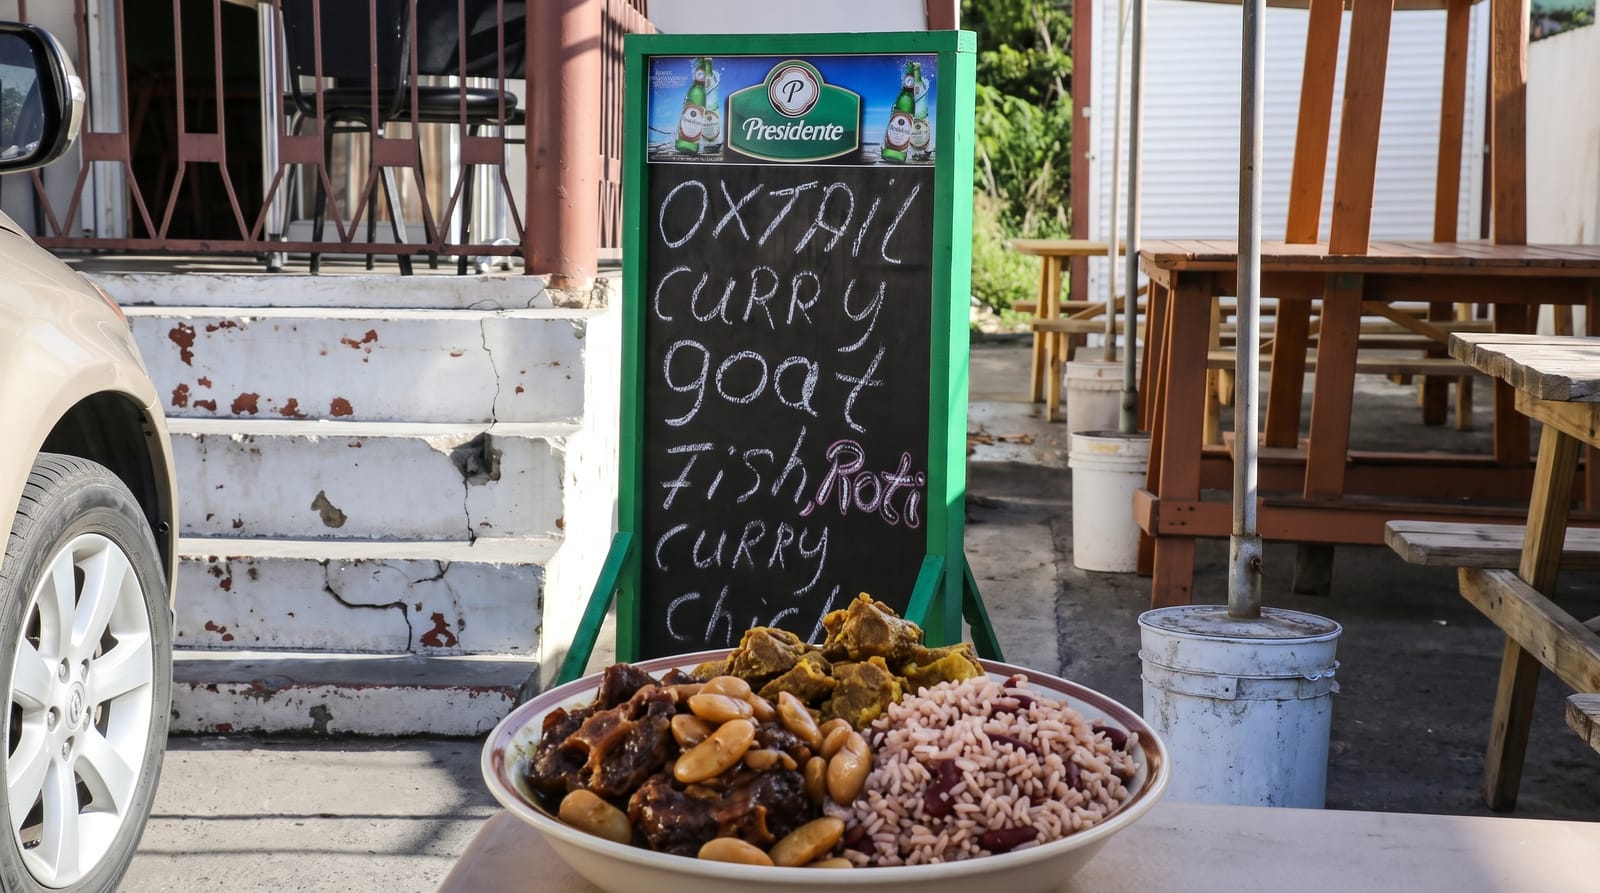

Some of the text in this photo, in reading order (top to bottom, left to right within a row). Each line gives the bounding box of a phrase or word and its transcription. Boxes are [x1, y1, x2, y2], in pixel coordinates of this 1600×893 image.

[782, 79, 804, 103] P
[742, 117, 844, 140] Presidente
[663, 338, 886, 433] goat
[815, 439, 926, 529] Roti
